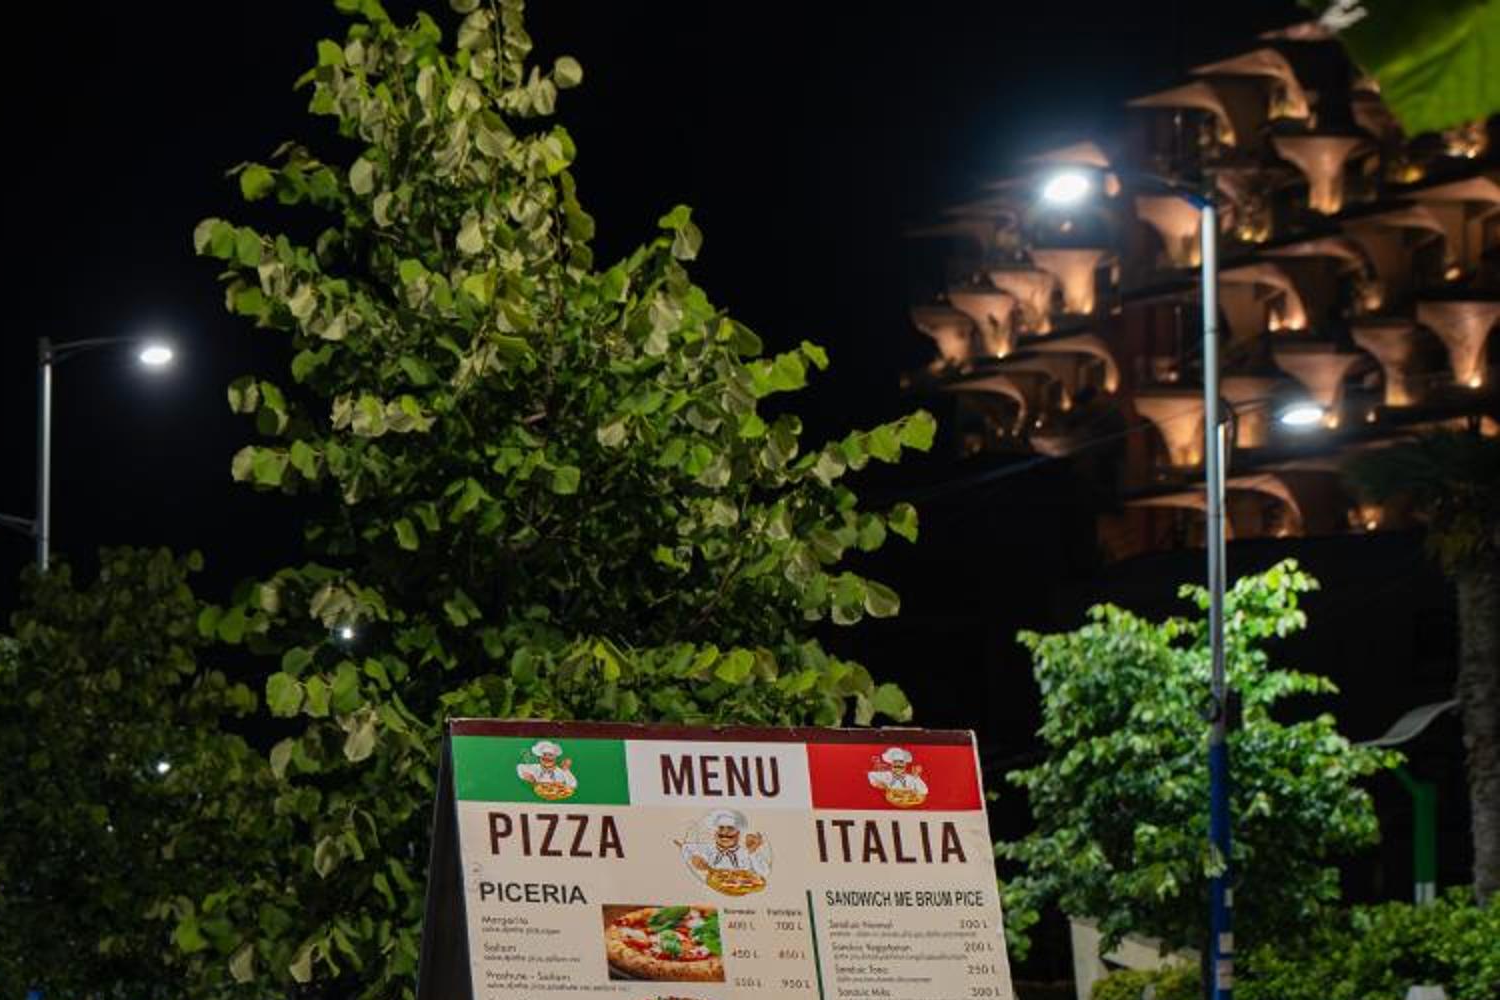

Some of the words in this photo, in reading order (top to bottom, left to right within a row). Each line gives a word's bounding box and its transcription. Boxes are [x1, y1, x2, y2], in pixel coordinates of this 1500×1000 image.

[660, 753, 781, 799] MENU
[488, 812, 625, 859] PIZZA
[816, 819, 967, 864] ITALIA
[479, 881, 588, 905] PICERIA
[825, 890, 891, 907] SANDWICH
[894, 891, 914, 907] ME
[915, 891, 953, 907] BRUM
[955, 891, 984, 907] PICE
[482, 915, 529, 926] Margarita
